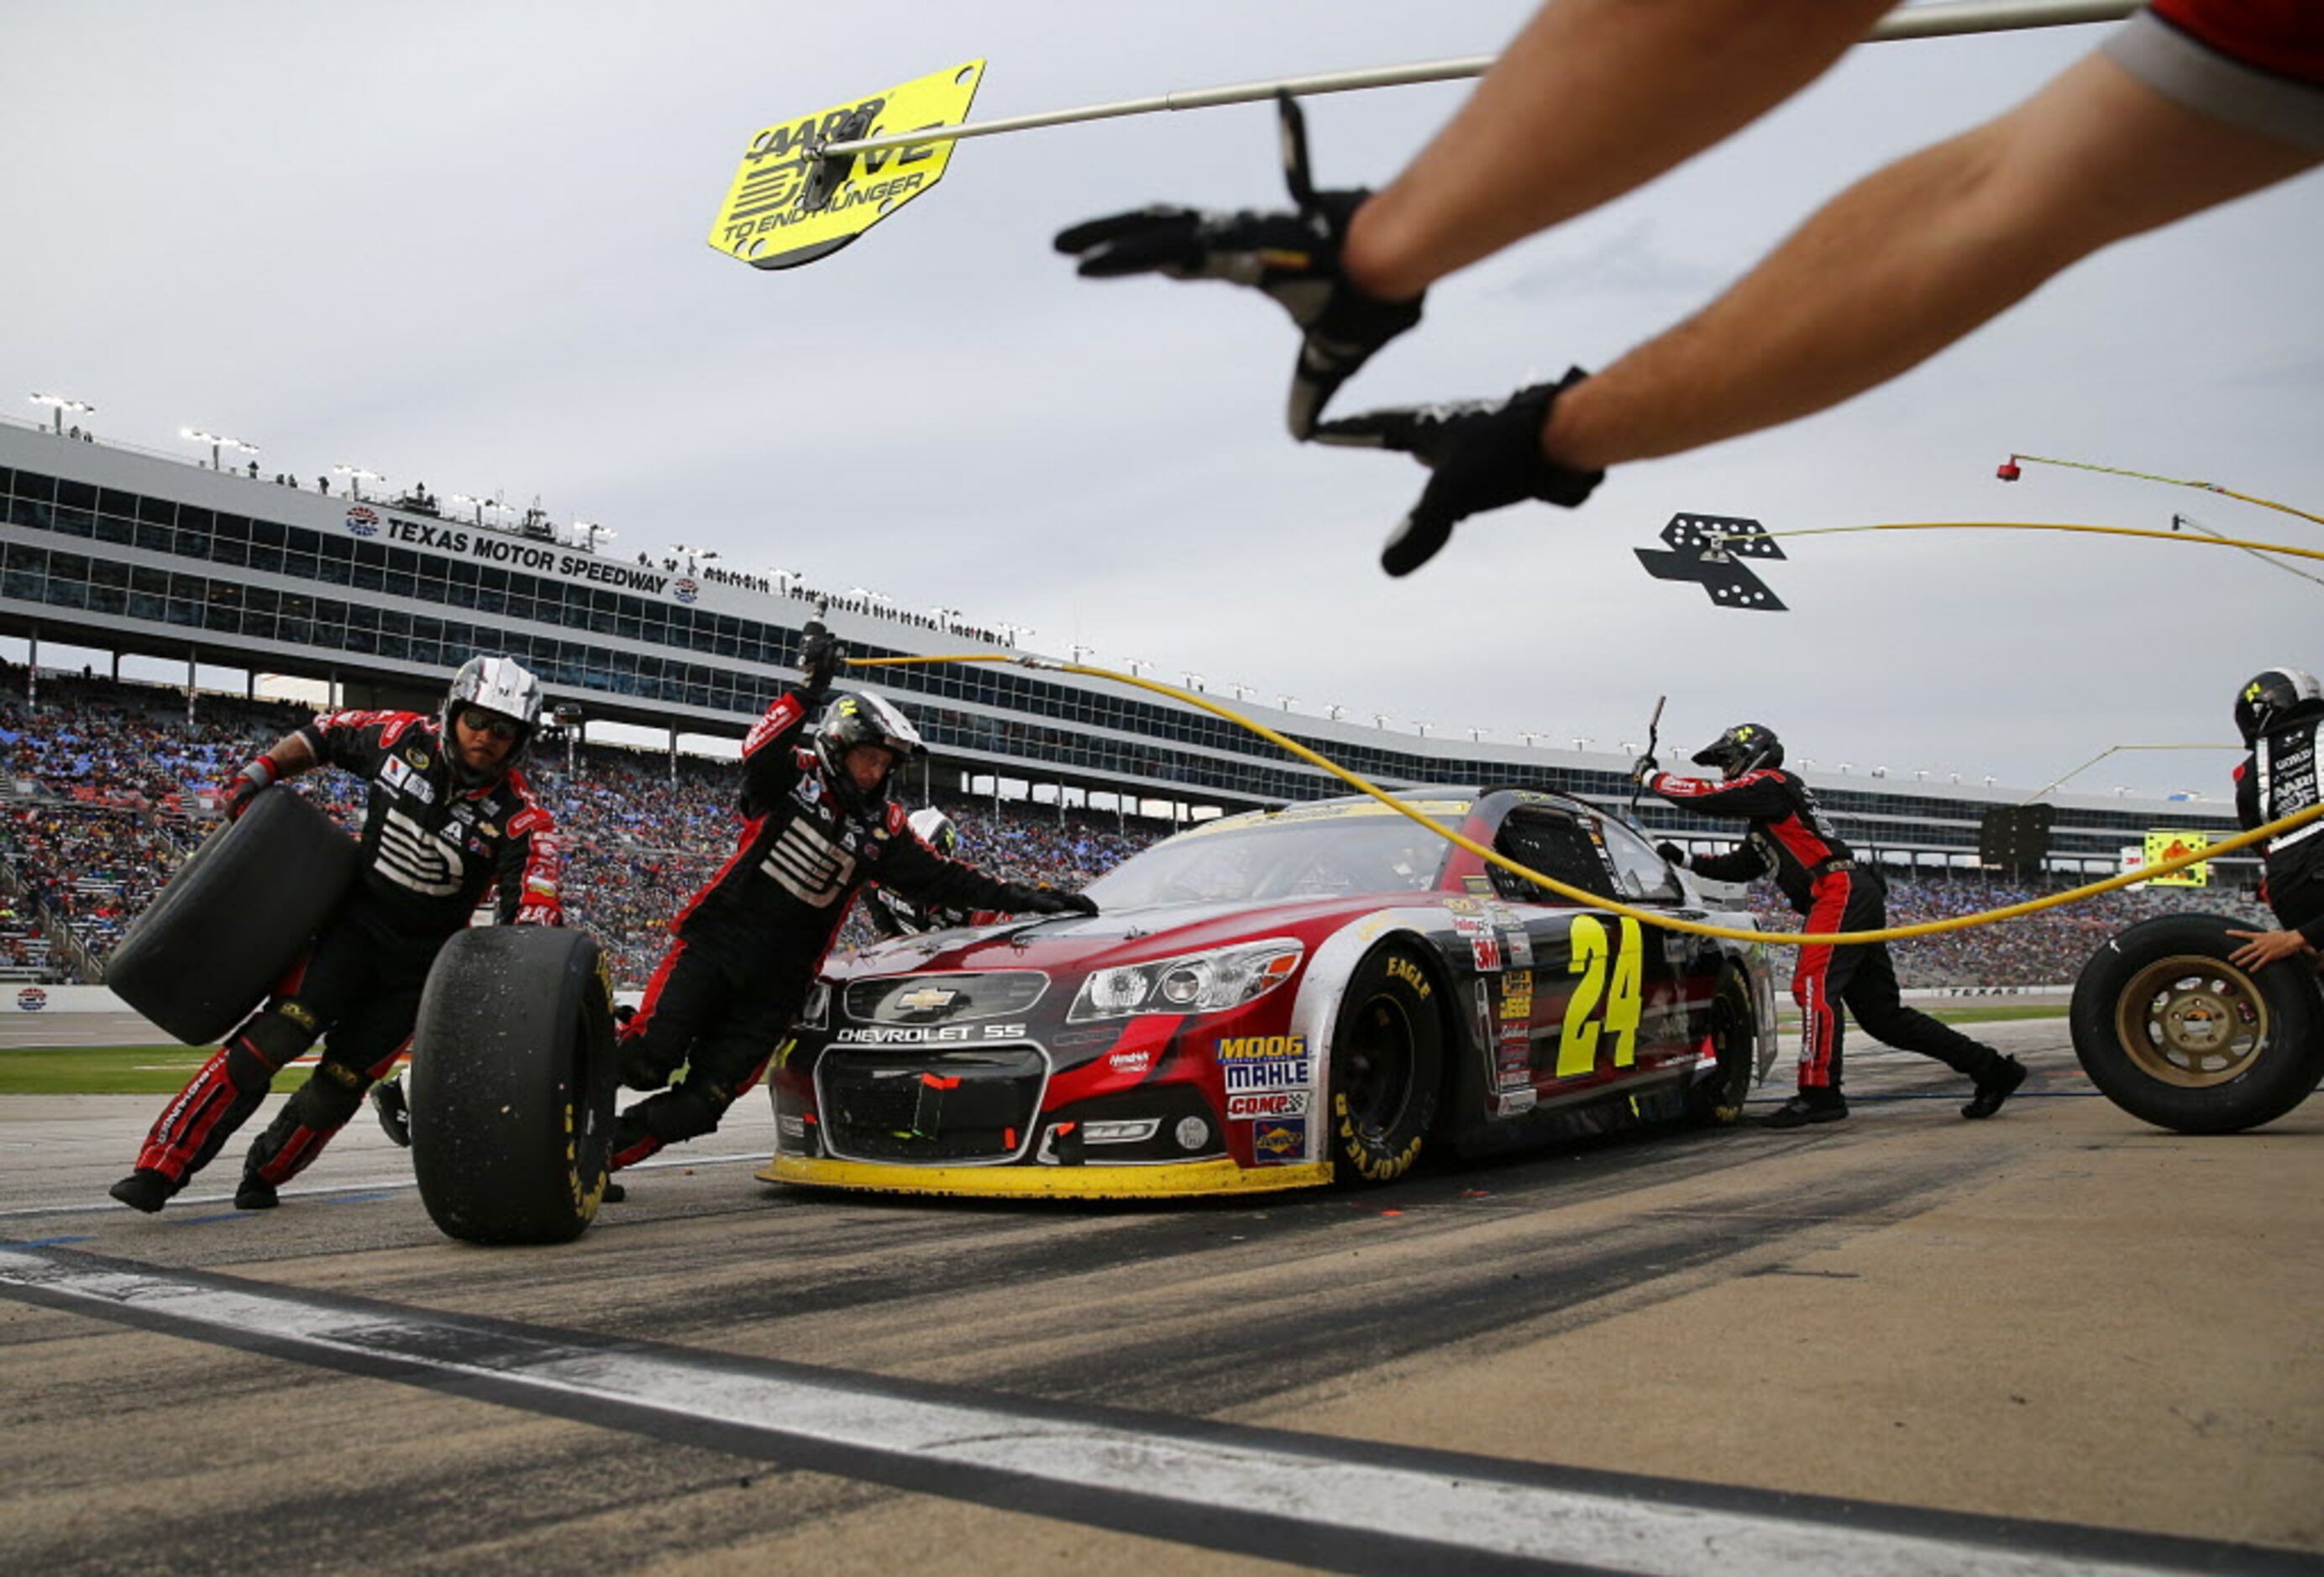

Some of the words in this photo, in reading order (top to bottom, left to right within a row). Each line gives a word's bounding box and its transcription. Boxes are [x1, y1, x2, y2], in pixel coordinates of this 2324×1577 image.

[724, 222, 755, 242] TO
[758, 207, 806, 233] END
[387, 517, 468, 553] TEXAS
[473, 537, 554, 571] MOTOR
[559, 554, 669, 595] SPEEDWAY
[1474, 940, 1500, 969] 3M
[1386, 956, 1431, 1000] EAGLE
[1556, 914, 1643, 1078] 24
[1949, 988, 2018, 998] TEXAS
[837, 1024, 974, 1043] CHEVROLET
[984, 1023, 1027, 1039] SS
[1219, 1035, 1304, 1059] MOOG
[1227, 1061, 1309, 1087] MAHLE
[1230, 1095, 1288, 1114] COMP
